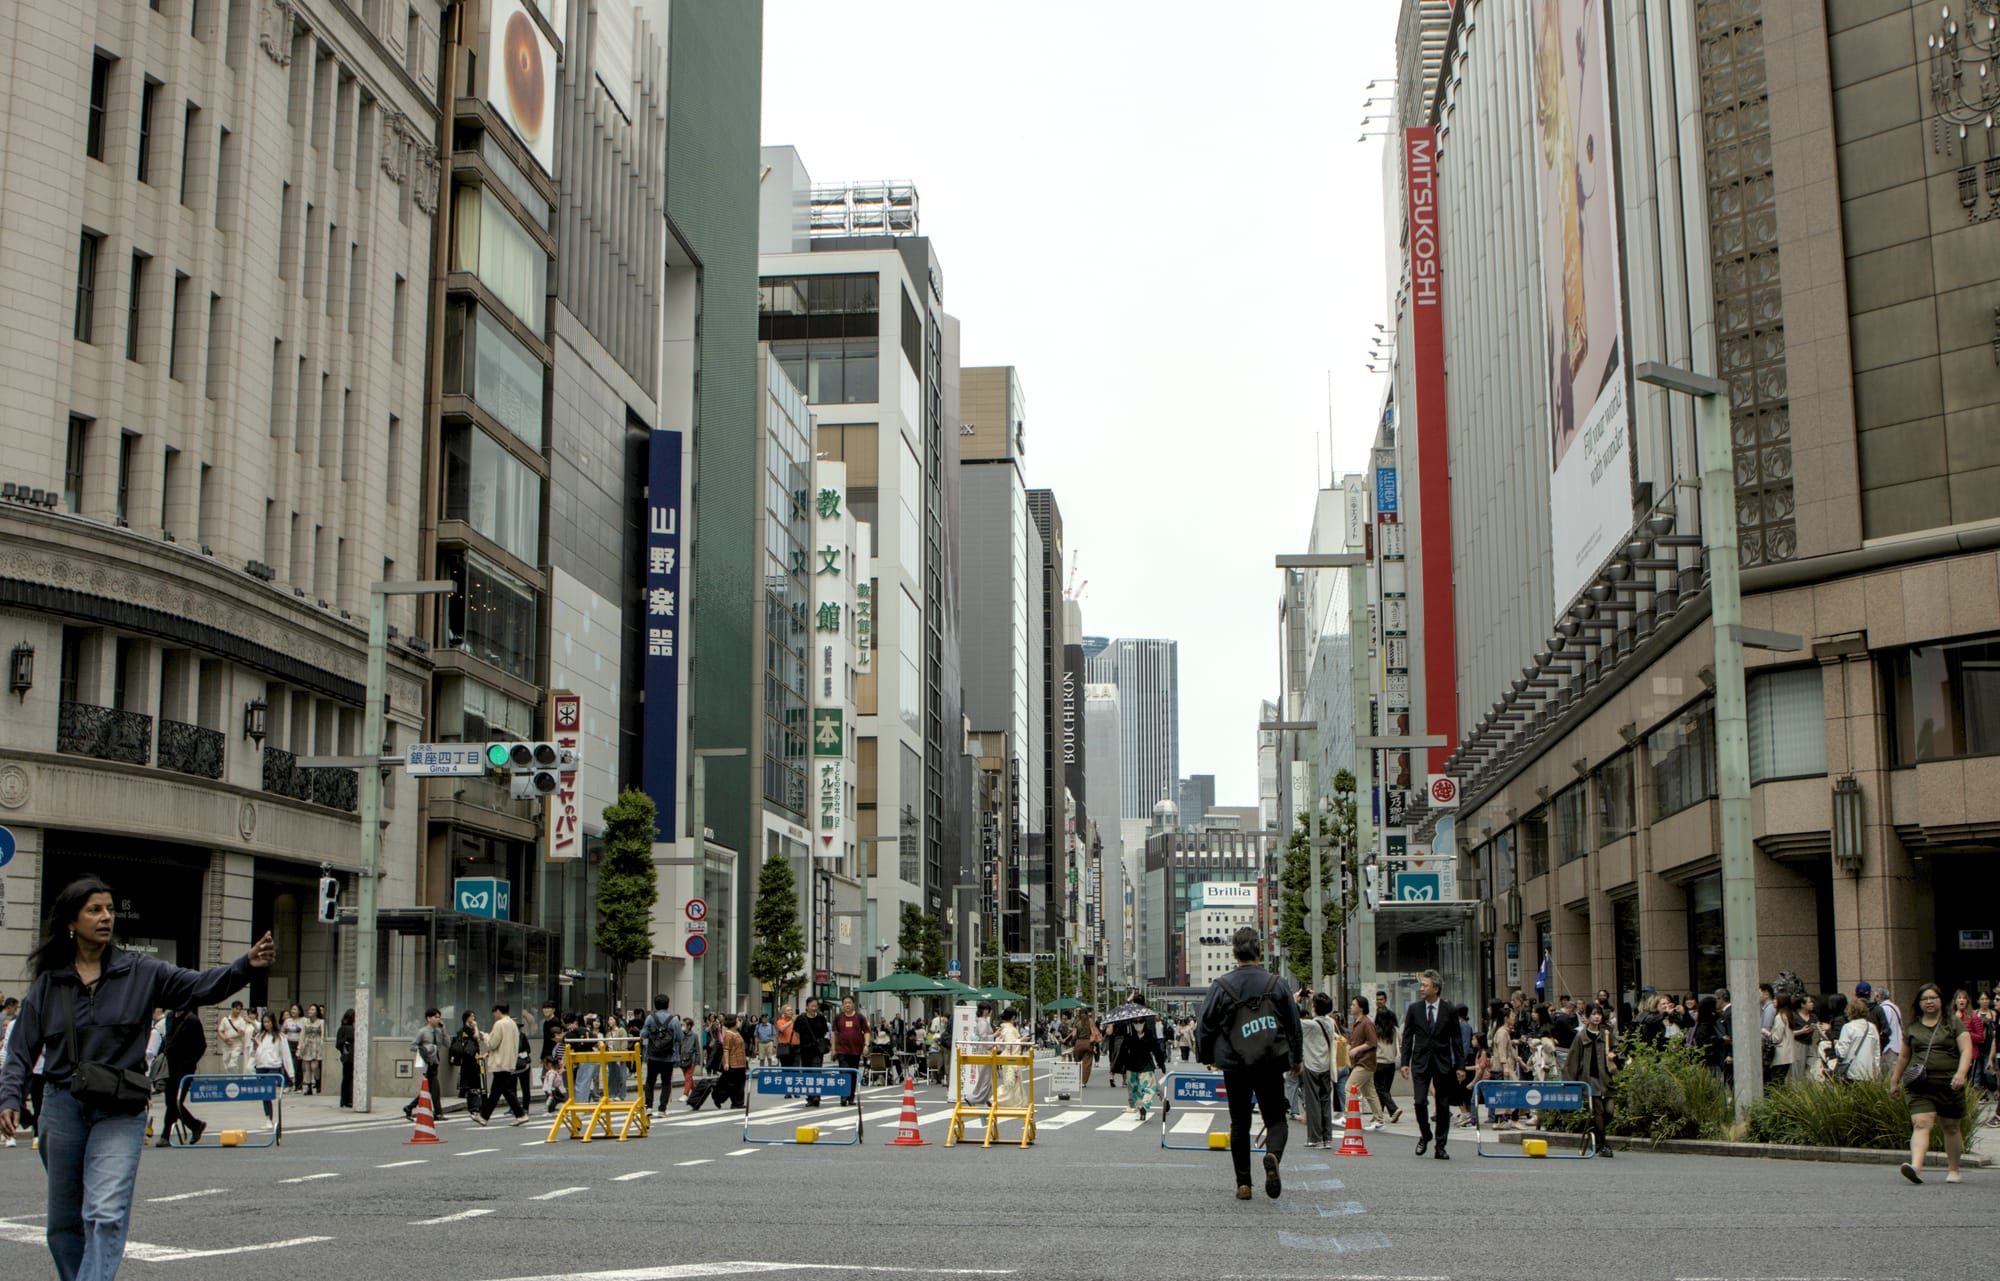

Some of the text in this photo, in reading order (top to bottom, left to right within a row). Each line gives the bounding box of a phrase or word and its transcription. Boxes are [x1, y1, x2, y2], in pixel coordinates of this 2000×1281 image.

[1411, 139, 1437, 305] MITSUKOSHI
[1583, 426, 1592, 460] Fill
[1605, 381, 1623, 423] world
[1603, 426, 1624, 469] wonder
[649, 507, 676, 657] 山野楽器
[815, 488, 841, 633] 教文館
[857, 583, 871, 666] 教文館ビル
[815, 715, 841, 749] 本
[1063, 671, 1075, 764] BOUCHERON
[410, 751, 479, 764] 銀座四丁目
[555, 737, 578, 850] キラヤのパン
[1208, 887, 1251, 896] Brillia
[1241, 1015, 1278, 1038] COYG
[763, 1075, 846, 1087] 歩行者天国実施中
